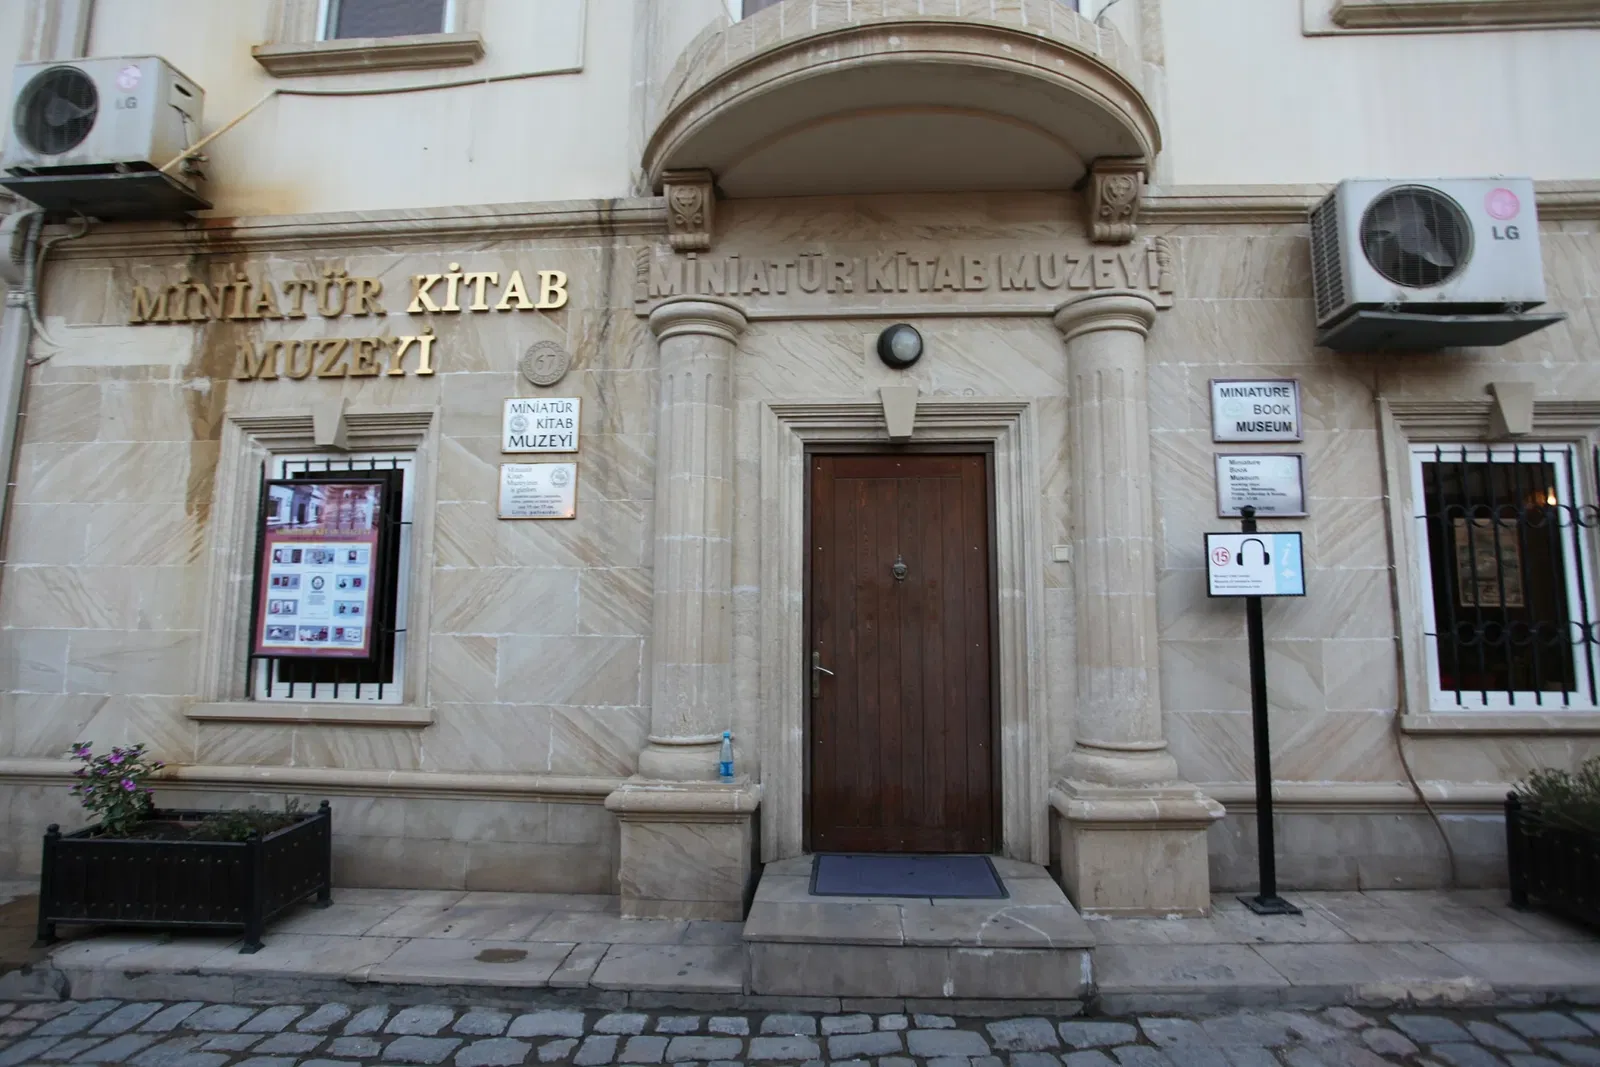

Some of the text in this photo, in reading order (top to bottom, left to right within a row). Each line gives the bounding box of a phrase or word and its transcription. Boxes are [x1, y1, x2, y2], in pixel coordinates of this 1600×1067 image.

[115, 96, 138, 110] LG
[1491, 225, 1521, 241] LG
[865, 251, 991, 294] KİTAB
[129, 261, 569, 324] MİNİATÜR KİTAB
[236, 324, 436, 381] MUZEYİ
[1220, 386, 1291, 398] MINIATURE
[509, 400, 573, 414] MİNİATÜR
[1252, 404, 1292, 415] BOOK
[536, 415, 574, 429] KİTAB
[1236, 421, 1293, 432] MUSEUM
[508, 431, 573, 448] MUZEYİ
[1214, 550, 1229, 563] 15
